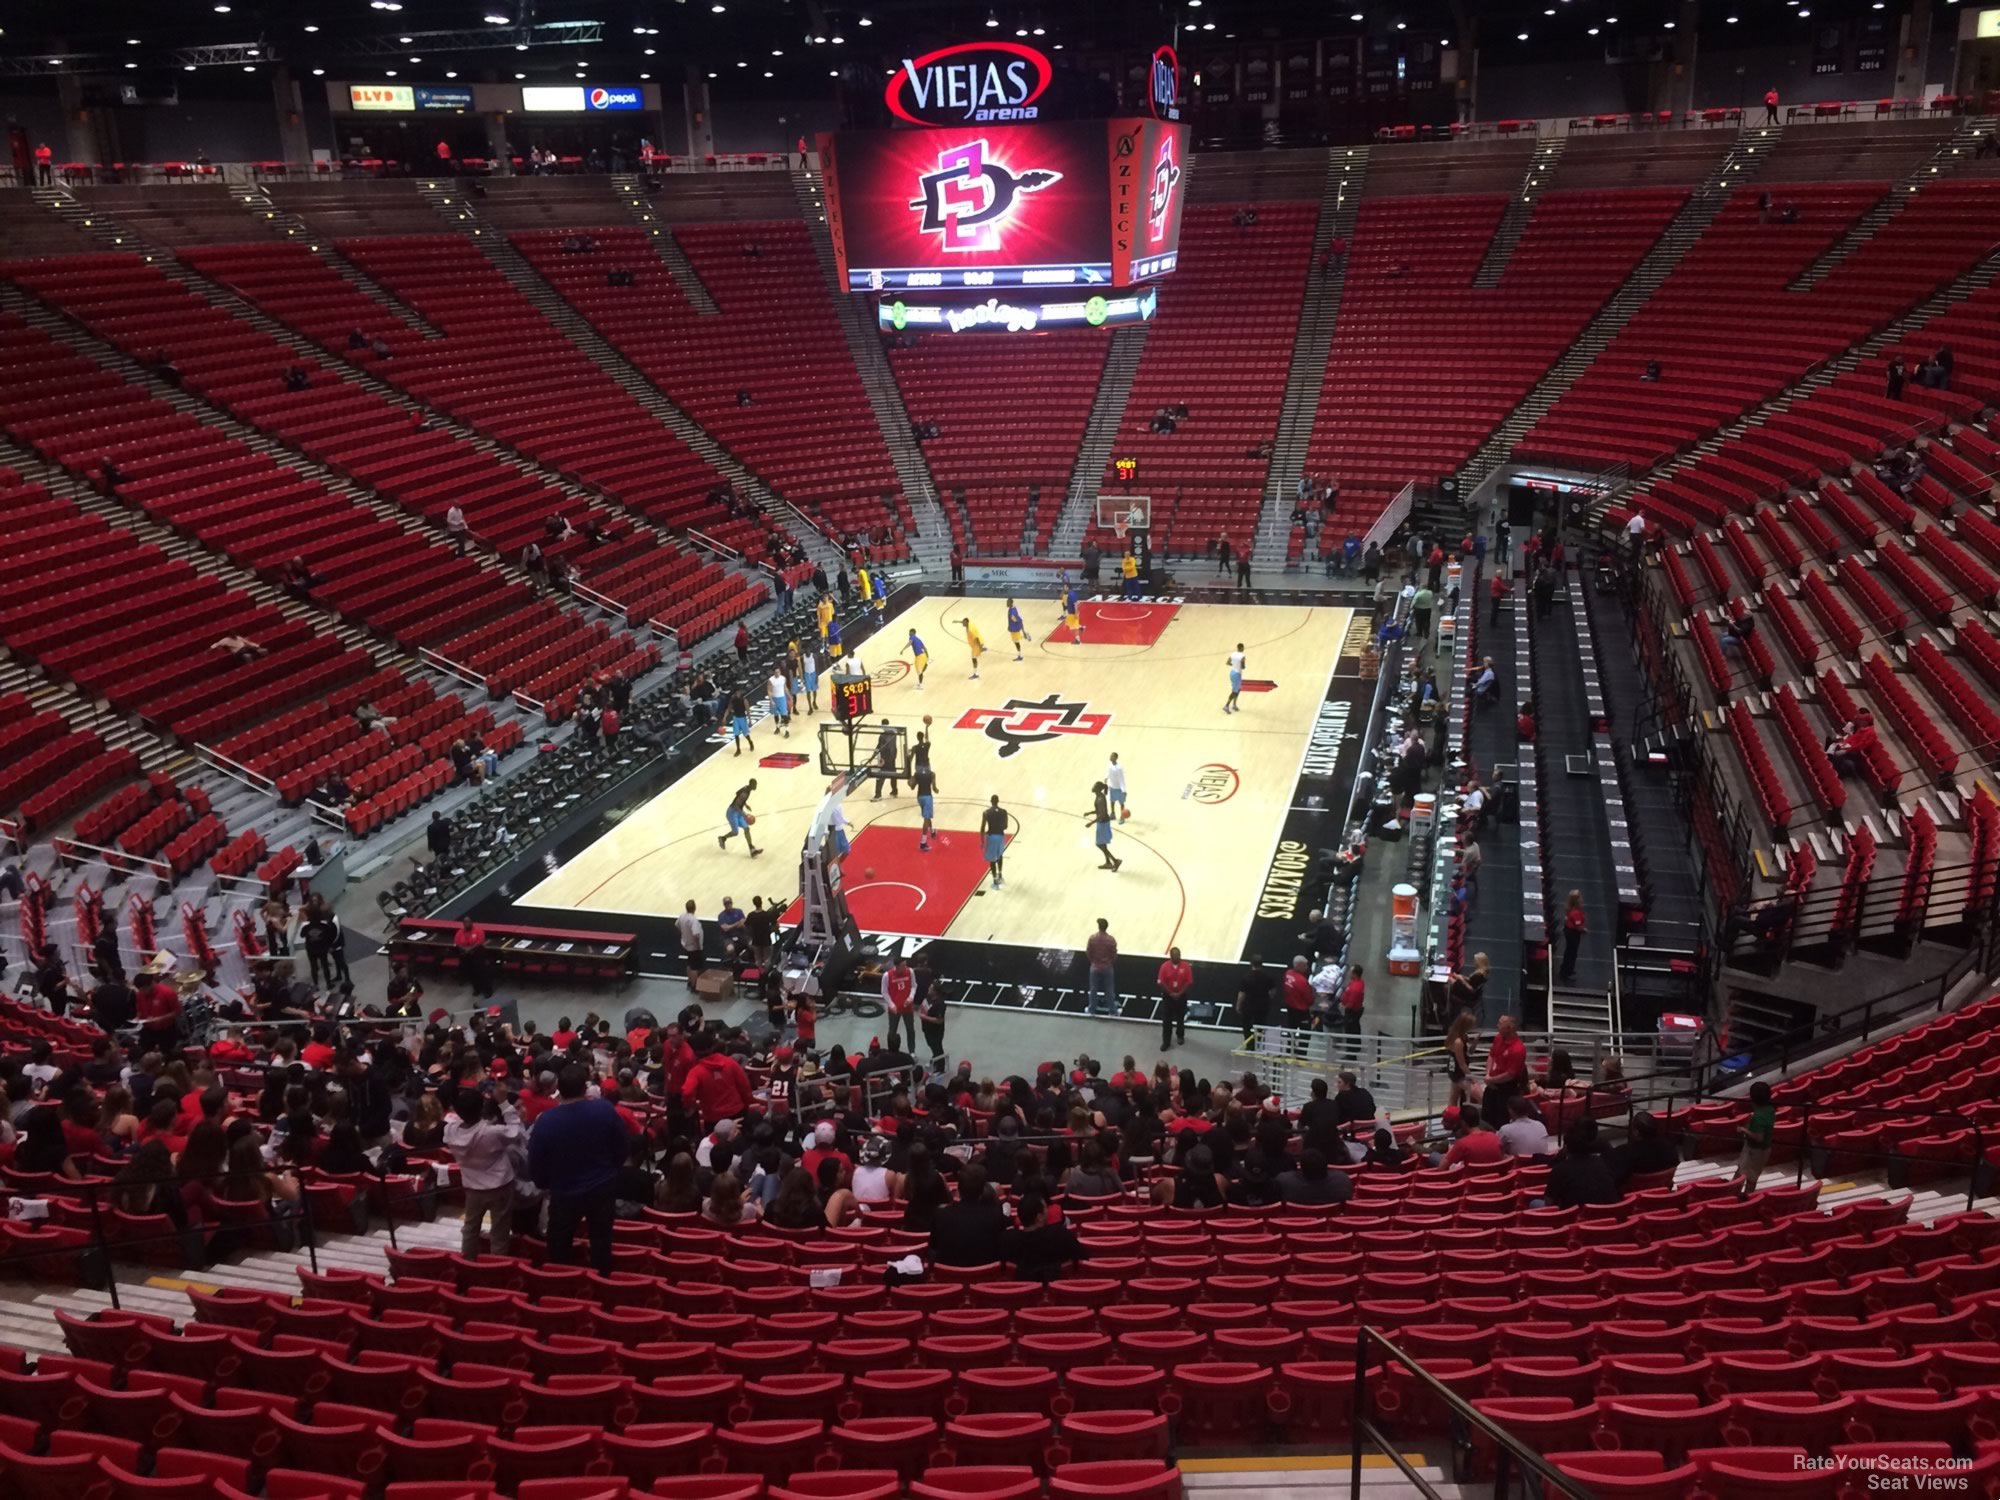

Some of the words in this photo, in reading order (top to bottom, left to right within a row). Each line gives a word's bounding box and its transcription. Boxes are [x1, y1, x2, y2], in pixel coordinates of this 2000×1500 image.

[352, 91, 393, 101] BLVD
[609, 93, 637, 104] pepsi
[902, 58, 1028, 119] VIEJAS
[975, 106, 1038, 121] arena
[1116, 135, 1134, 251] AZTECS
[1119, 468, 1135, 480] 31
[843, 680, 870, 697] 59:07
[848, 693, 867, 716] 31
[1322, 700, 1352, 717] SAN
[1311, 717, 1348, 745] DIEGO
[1301, 745, 1339, 776] STATE
[1192, 768, 1239, 799] VIEJAS
[1256, 840, 1311, 920] @GOAZTECS
[771, 1080, 789, 1097] 21
